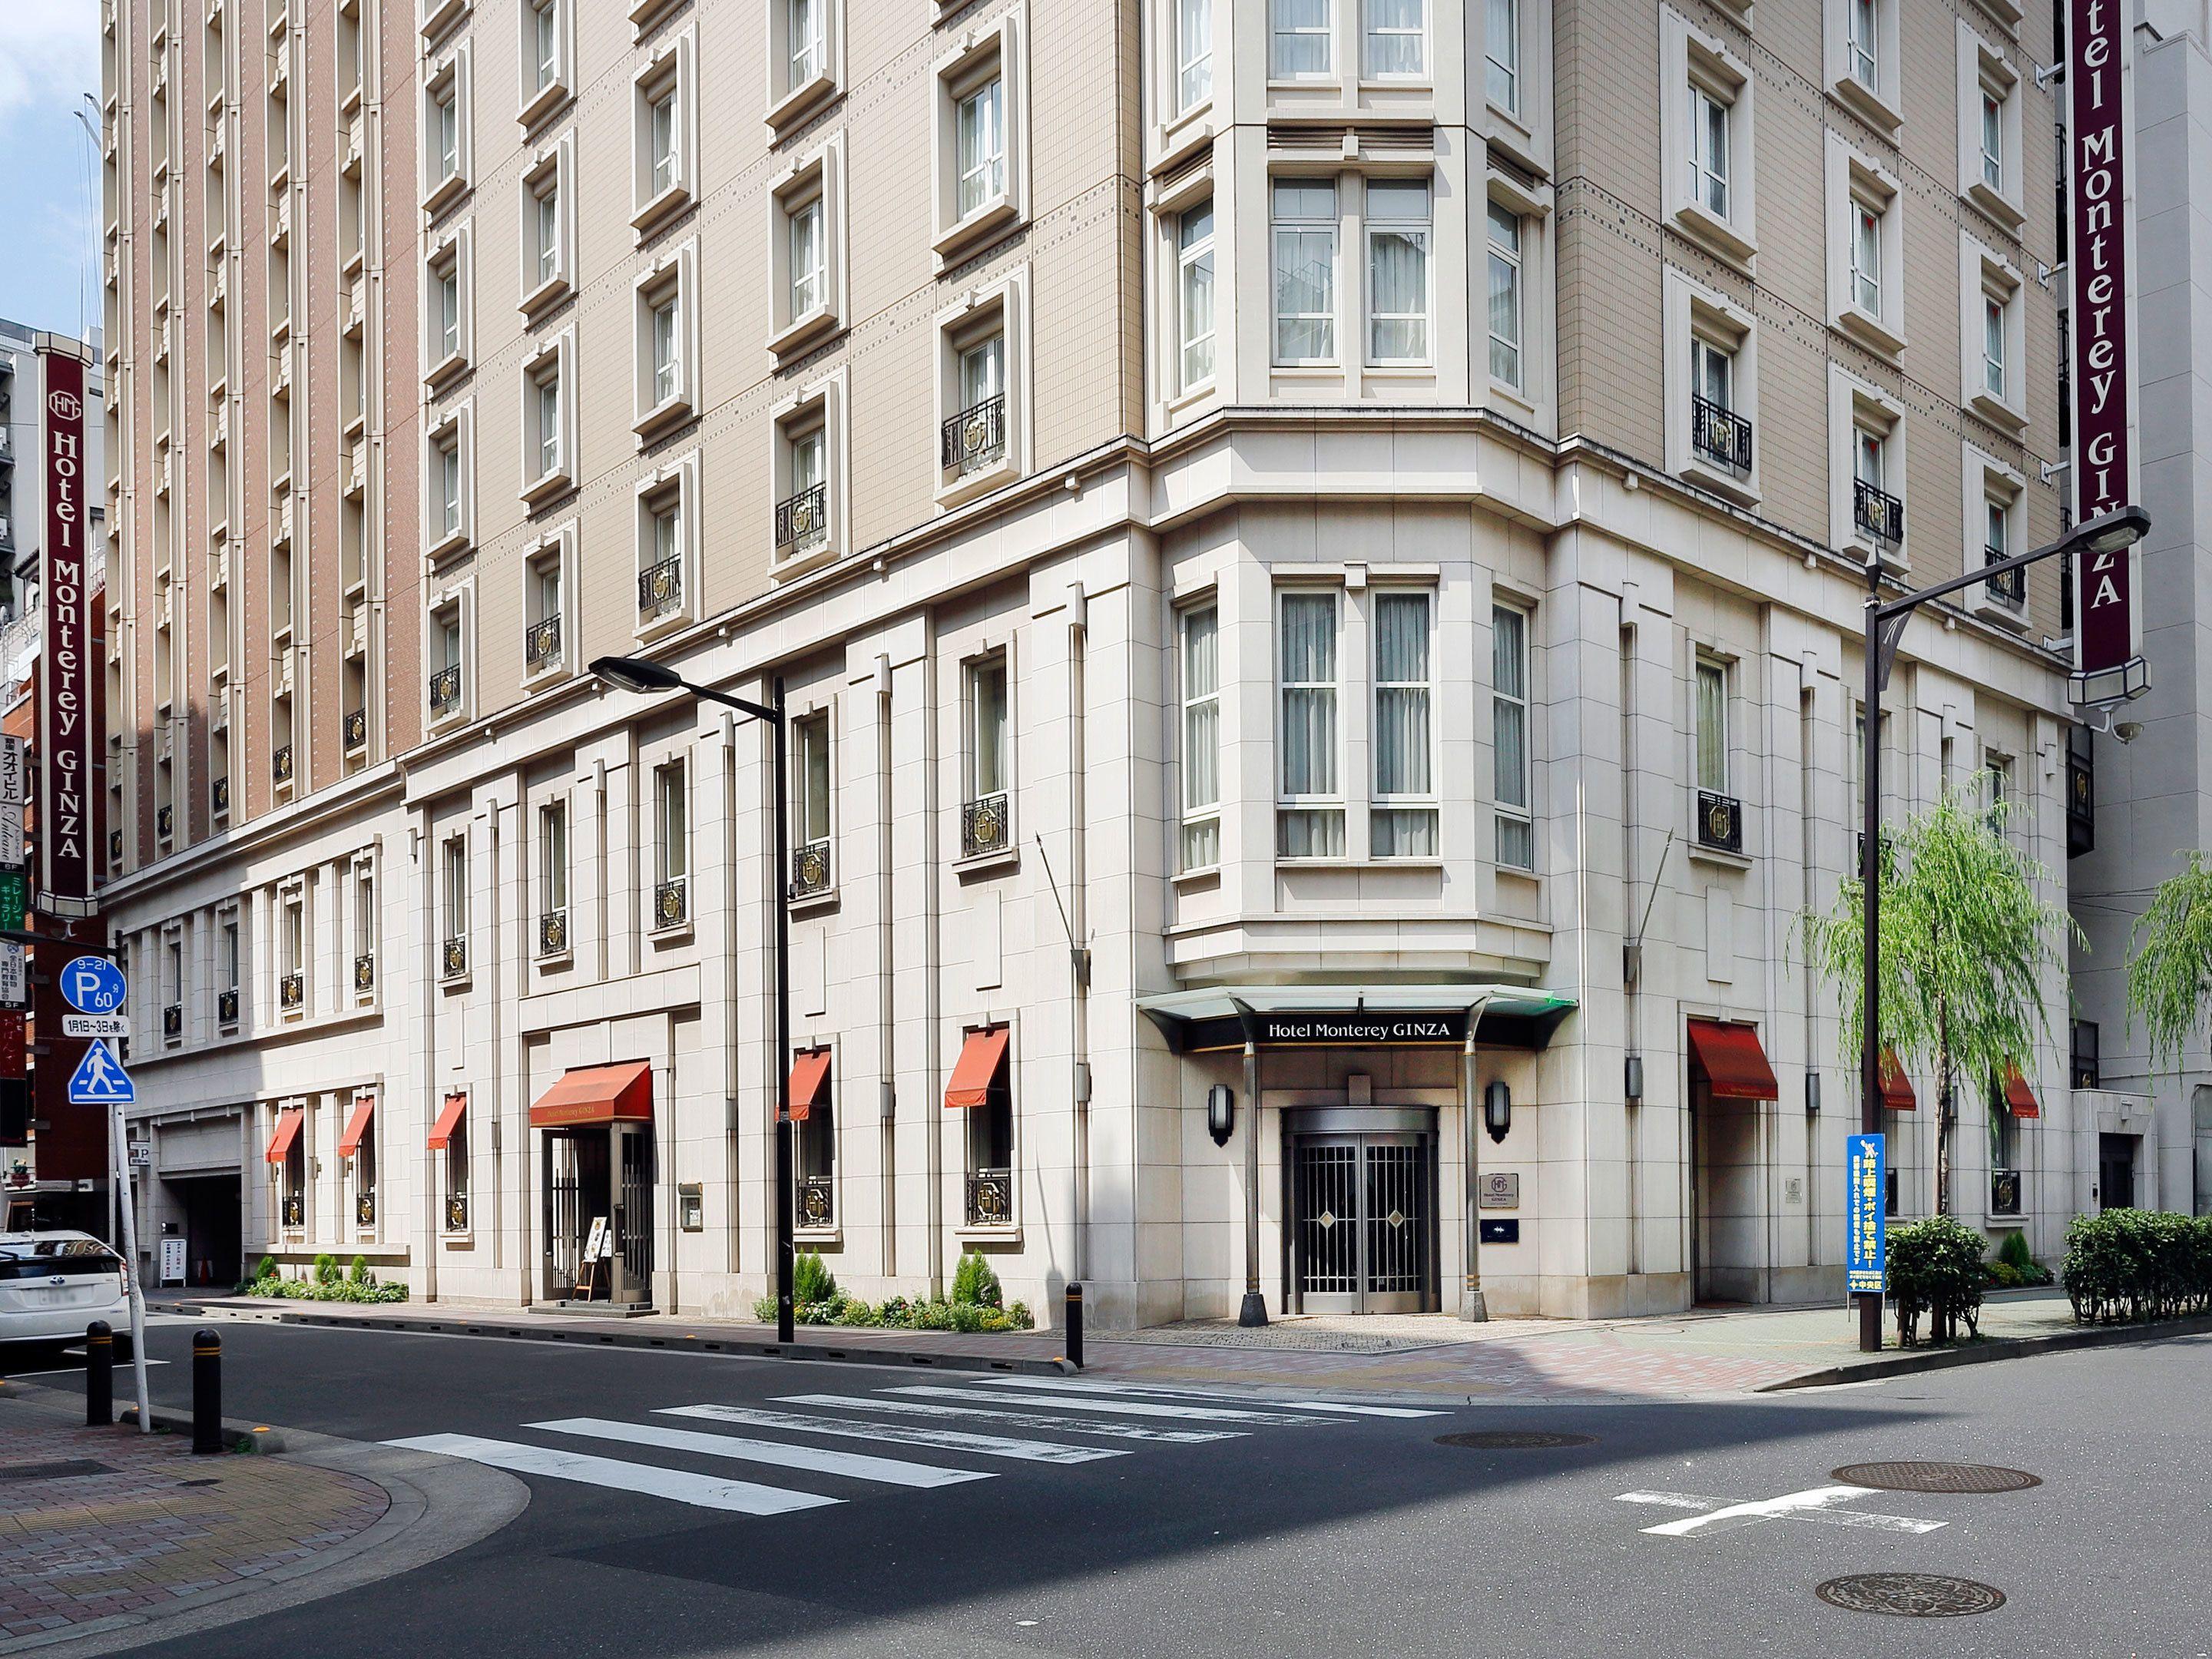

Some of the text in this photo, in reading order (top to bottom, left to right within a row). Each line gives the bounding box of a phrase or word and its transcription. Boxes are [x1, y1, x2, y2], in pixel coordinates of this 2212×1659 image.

[2081, 124, 2116, 415] Monterey
[53, 430, 81, 859] Hotel Monterey GINZA
[78, 959, 107, 970] 9-21
[76, 972, 101, 1007] P
[1269, 1023, 1450, 1039] Hotel Monterey GINZA
[141, 1149, 149, 1158] P
